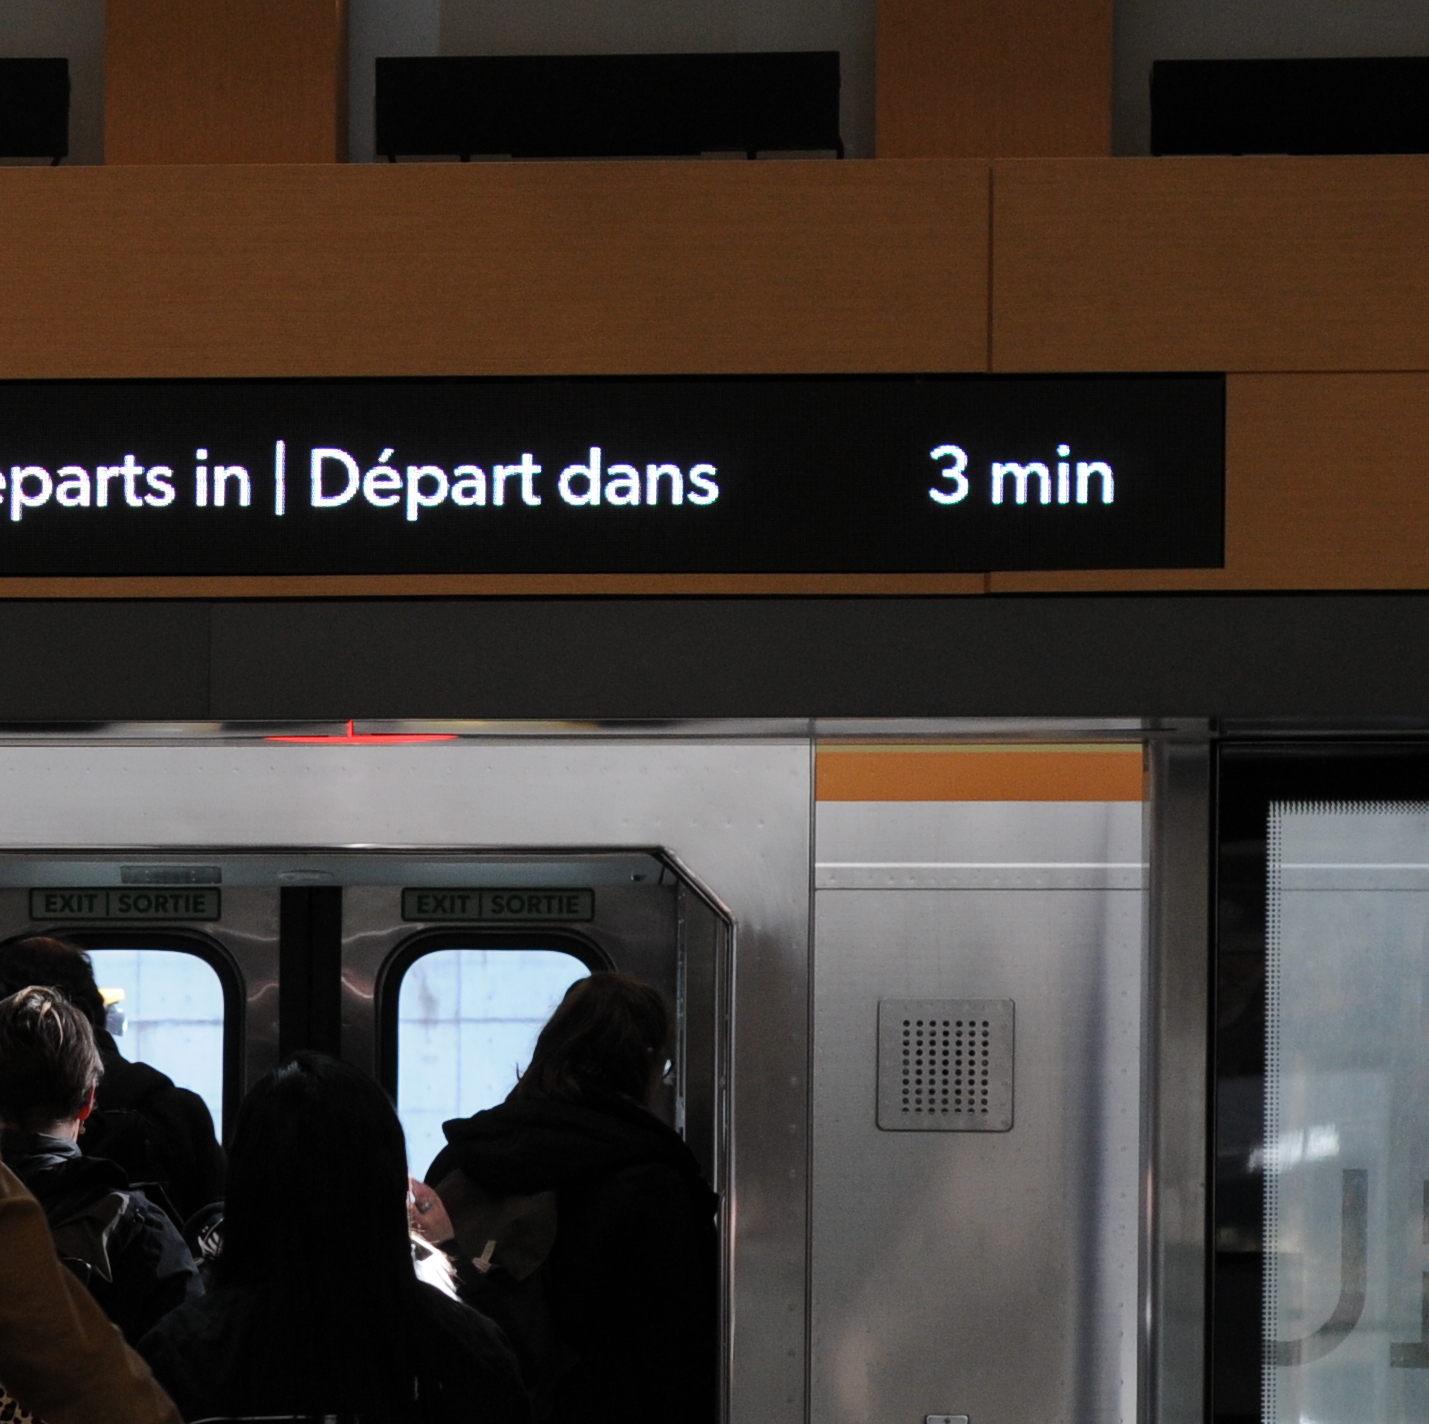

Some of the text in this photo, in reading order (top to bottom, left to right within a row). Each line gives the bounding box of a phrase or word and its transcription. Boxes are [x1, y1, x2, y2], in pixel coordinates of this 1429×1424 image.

[195, 448, 251, 508] in
[310, 441, 542, 522] Départ
[557, 446, 720, 506] dans
[928, 444, 1115, 505] 3 min
[44, 893, 206, 914] EXIT SORTIE
[417, 894, 579, 915] EXIT SORTIE
